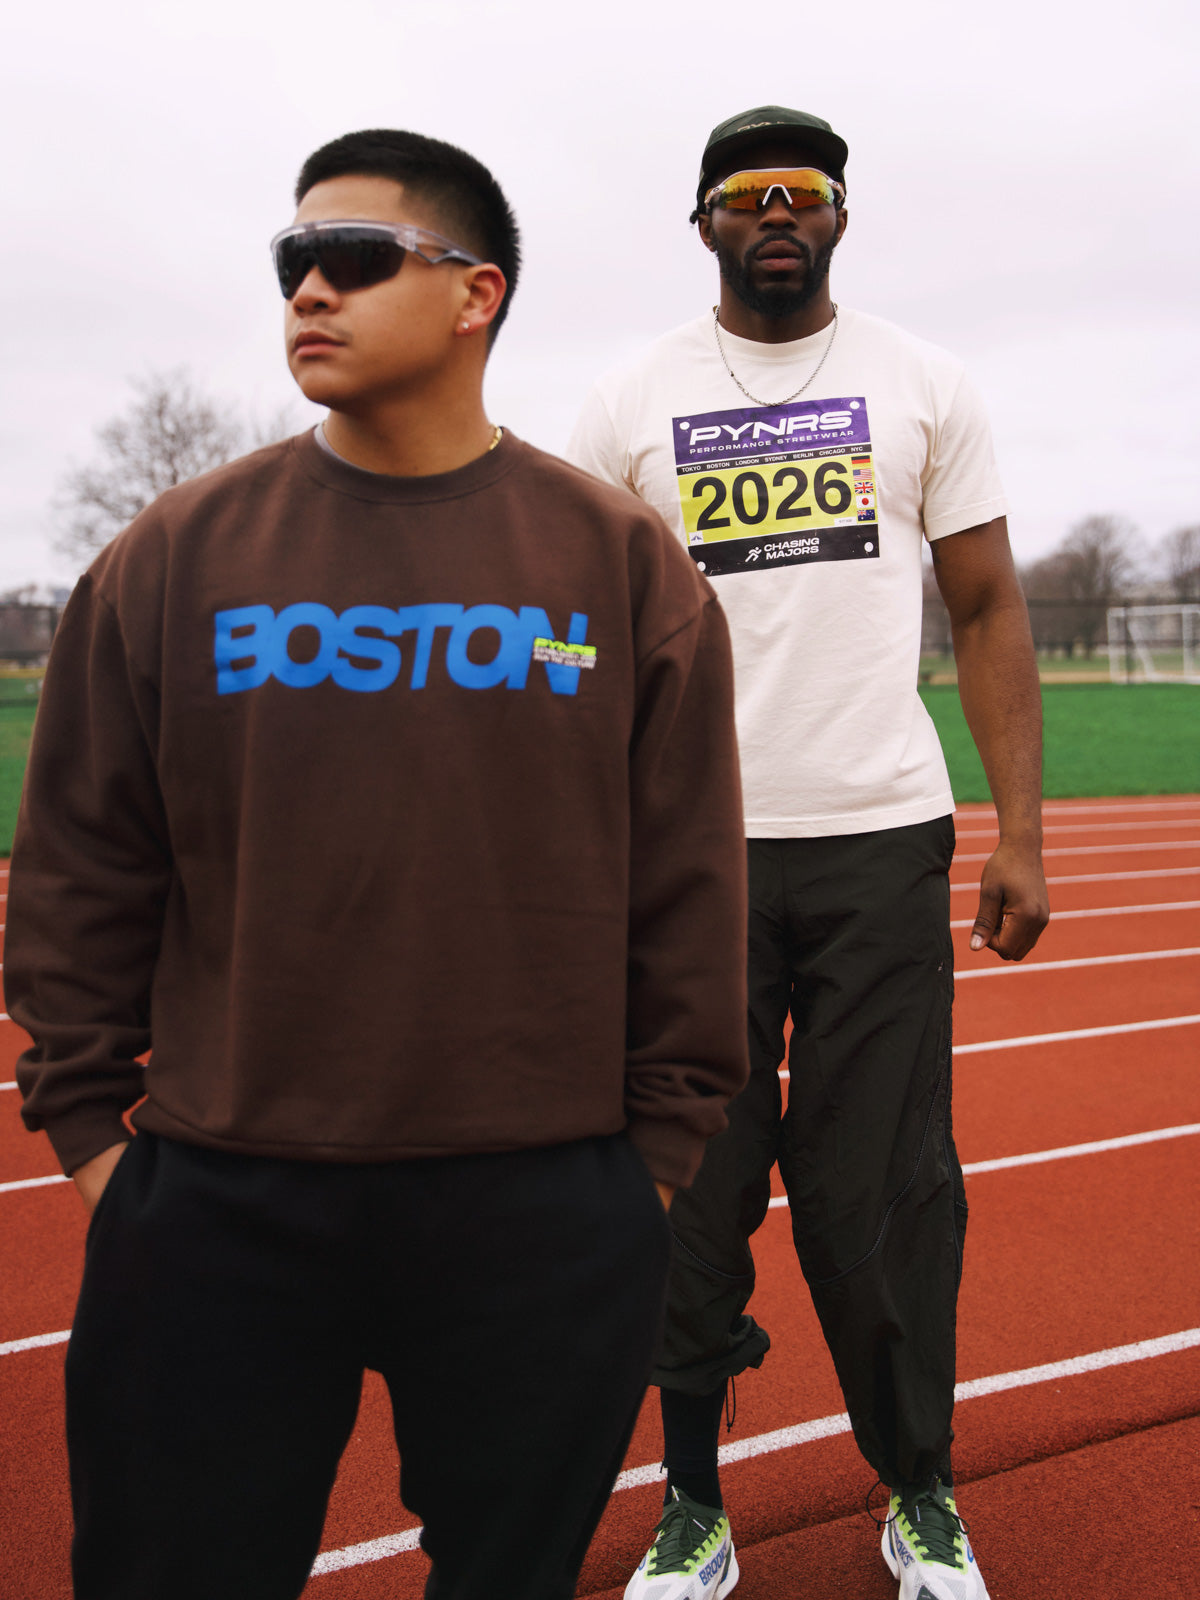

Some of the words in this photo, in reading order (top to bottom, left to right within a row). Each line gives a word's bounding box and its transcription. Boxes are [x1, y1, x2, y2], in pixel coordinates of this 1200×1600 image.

[689, 410, 853, 445] PYNRS
[689, 440, 771, 455] PERFORMANCE
[777, 430, 854, 445] STREETWEAR
[682, 465, 701, 473] TOKYO
[706, 461, 730, 470] BOSTON
[735, 458, 760, 466] LONDON
[764, 455, 788, 463] SYDNEY
[792, 451, 814, 459] BERLIN
[818, 447, 846, 456] CHICAGO
[692, 461, 852, 531] 2026
[763, 537, 820, 552] CHASING
[766, 545, 819, 560] MAJORS
[214, 602, 588, 696] BOSTON
